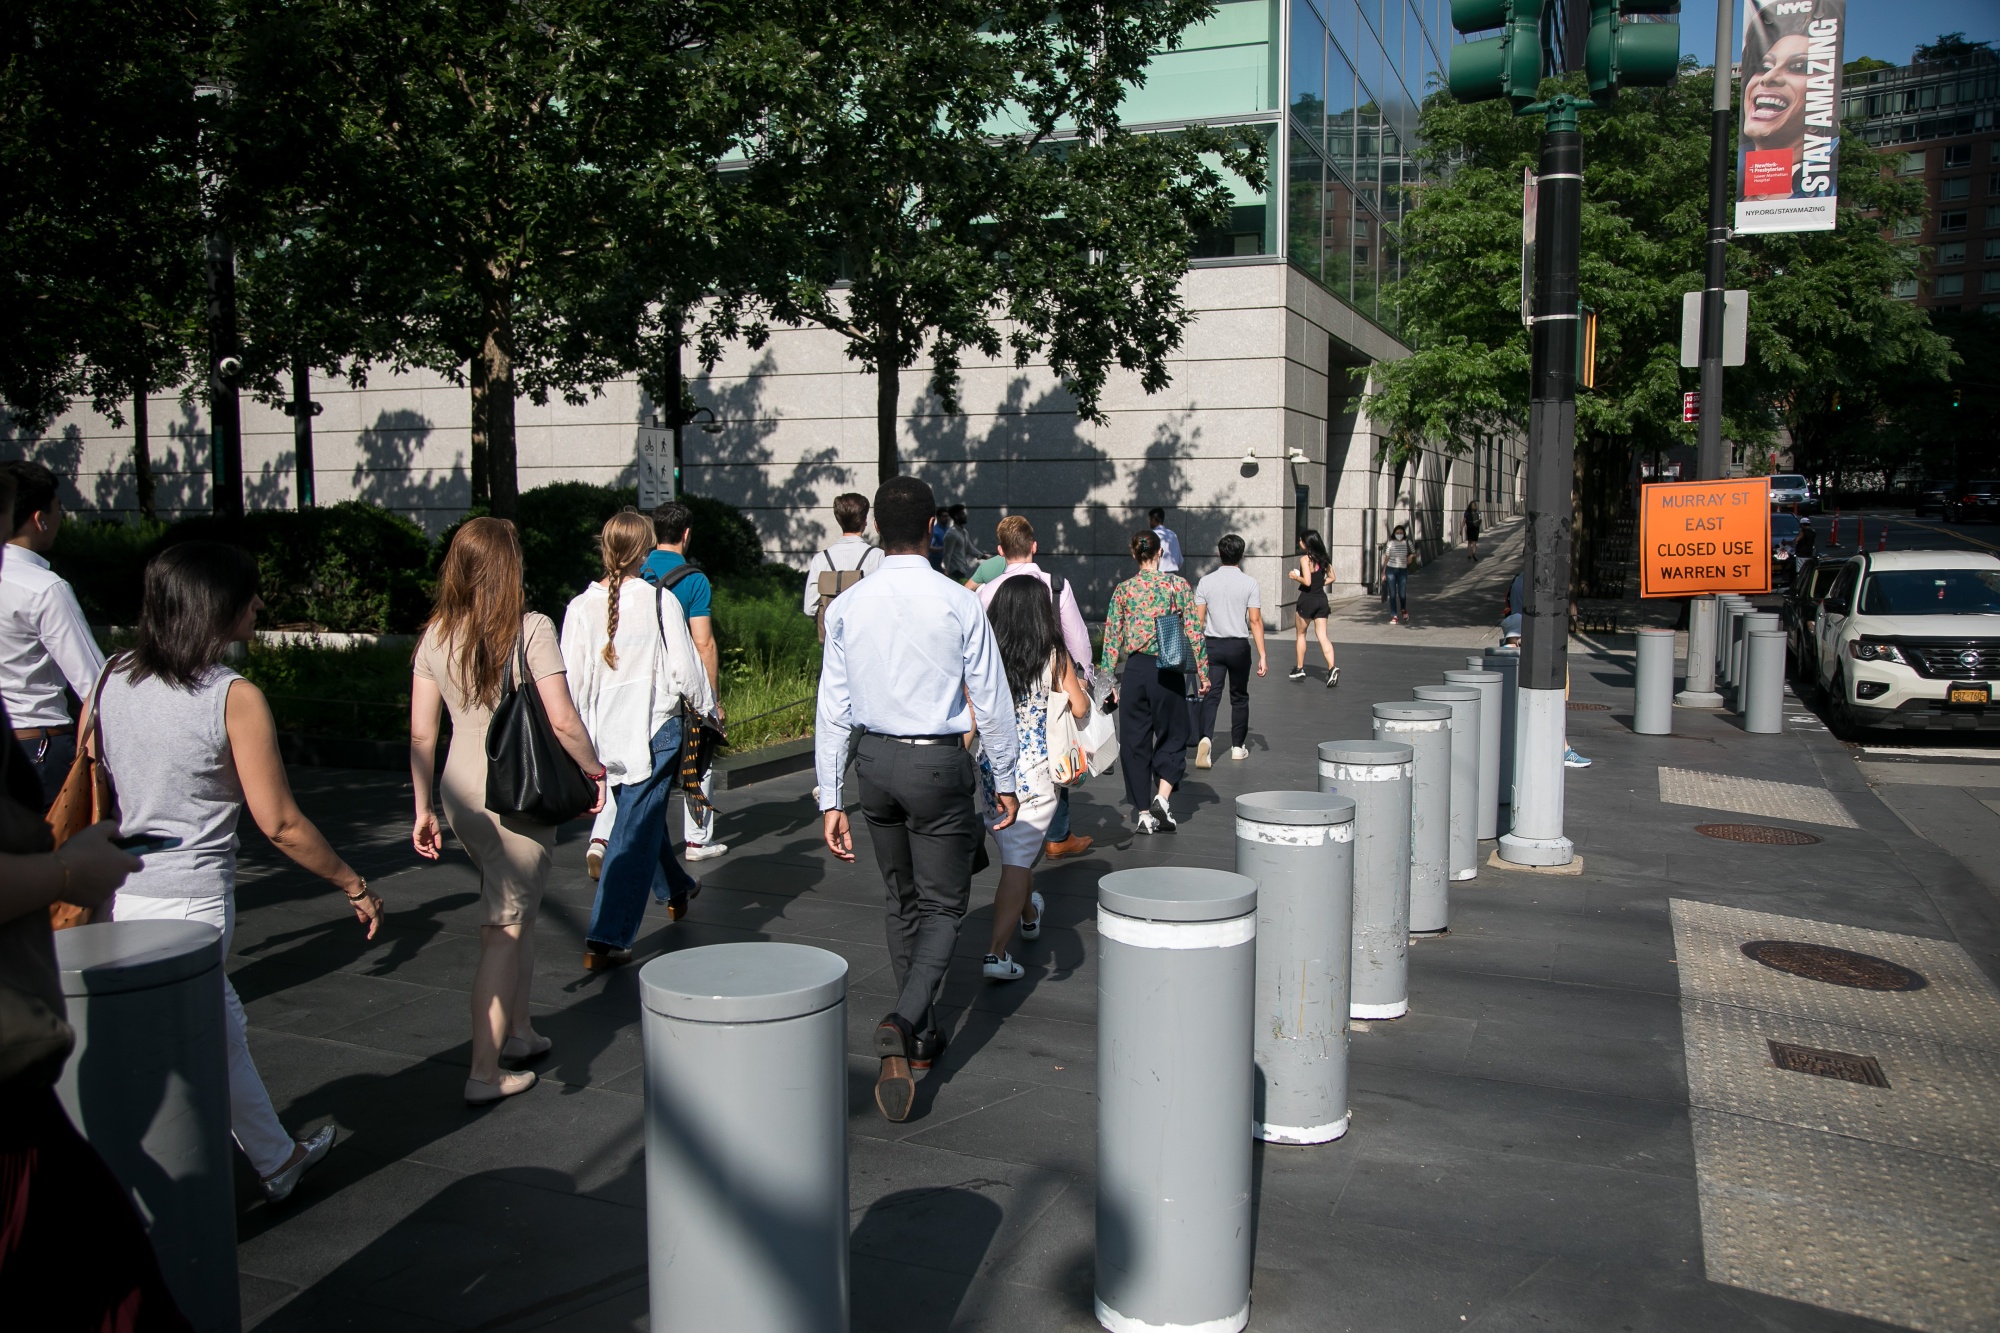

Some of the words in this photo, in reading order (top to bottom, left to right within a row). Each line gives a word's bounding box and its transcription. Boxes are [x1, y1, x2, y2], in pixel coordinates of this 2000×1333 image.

[1777, 1, 1812, 16] NYC
[1805, 18, 1838, 128] AMAZING
[1801, 133, 1832, 193] STAY
[1745, 205, 1826, 216] NYP.ORG/STAYAMAZING
[1662, 493, 1726, 508] MURRAY
[1731, 492, 1750, 506] ST
[1685, 517, 1725, 531] EAST
[1657, 542, 1717, 557] CLOSED
[1722, 541, 1754, 555] USE
[1660, 565, 1726, 580] WARREN
[1732, 564, 1751, 578] ST
